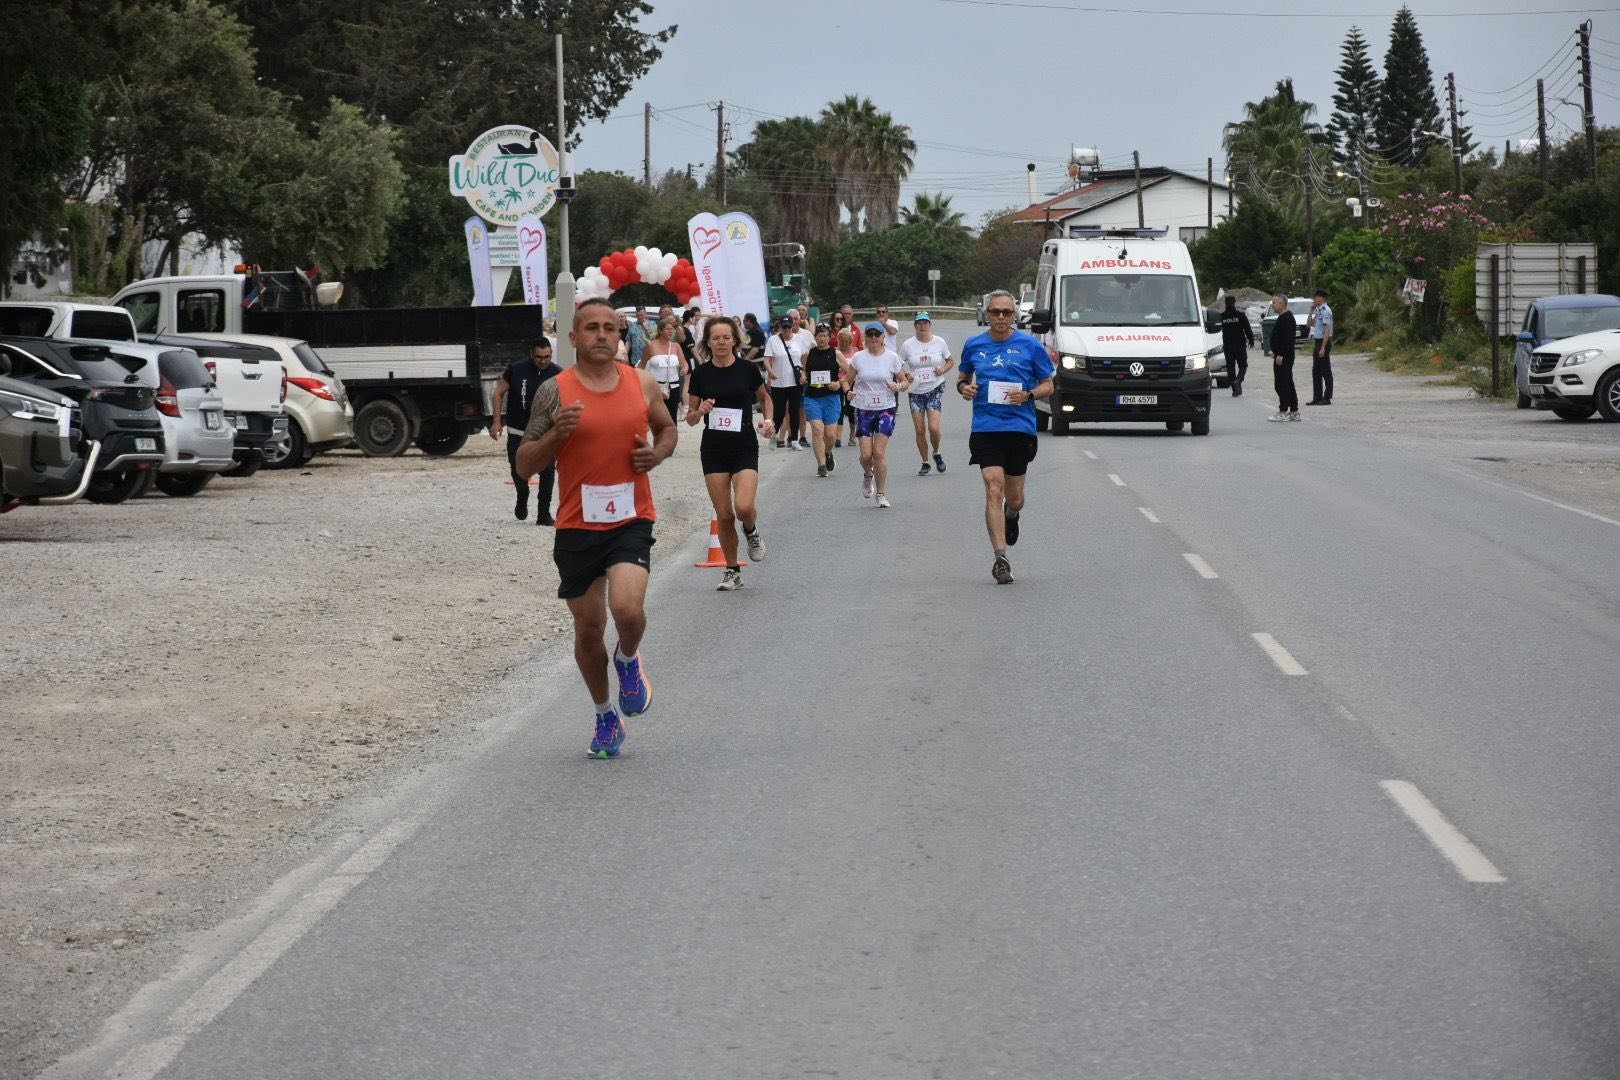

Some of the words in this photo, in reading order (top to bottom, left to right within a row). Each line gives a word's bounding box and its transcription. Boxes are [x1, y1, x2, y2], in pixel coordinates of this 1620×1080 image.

[470, 129, 528, 160] RESTAURANT
[454, 161, 508, 189] Wild
[513, 162, 560, 188] Duc
[475, 199, 496, 217] CAFE
[1080, 259, 1172, 270] AMBULANS
[717, 417, 731, 427] 19
[604, 500, 616, 515] 4
